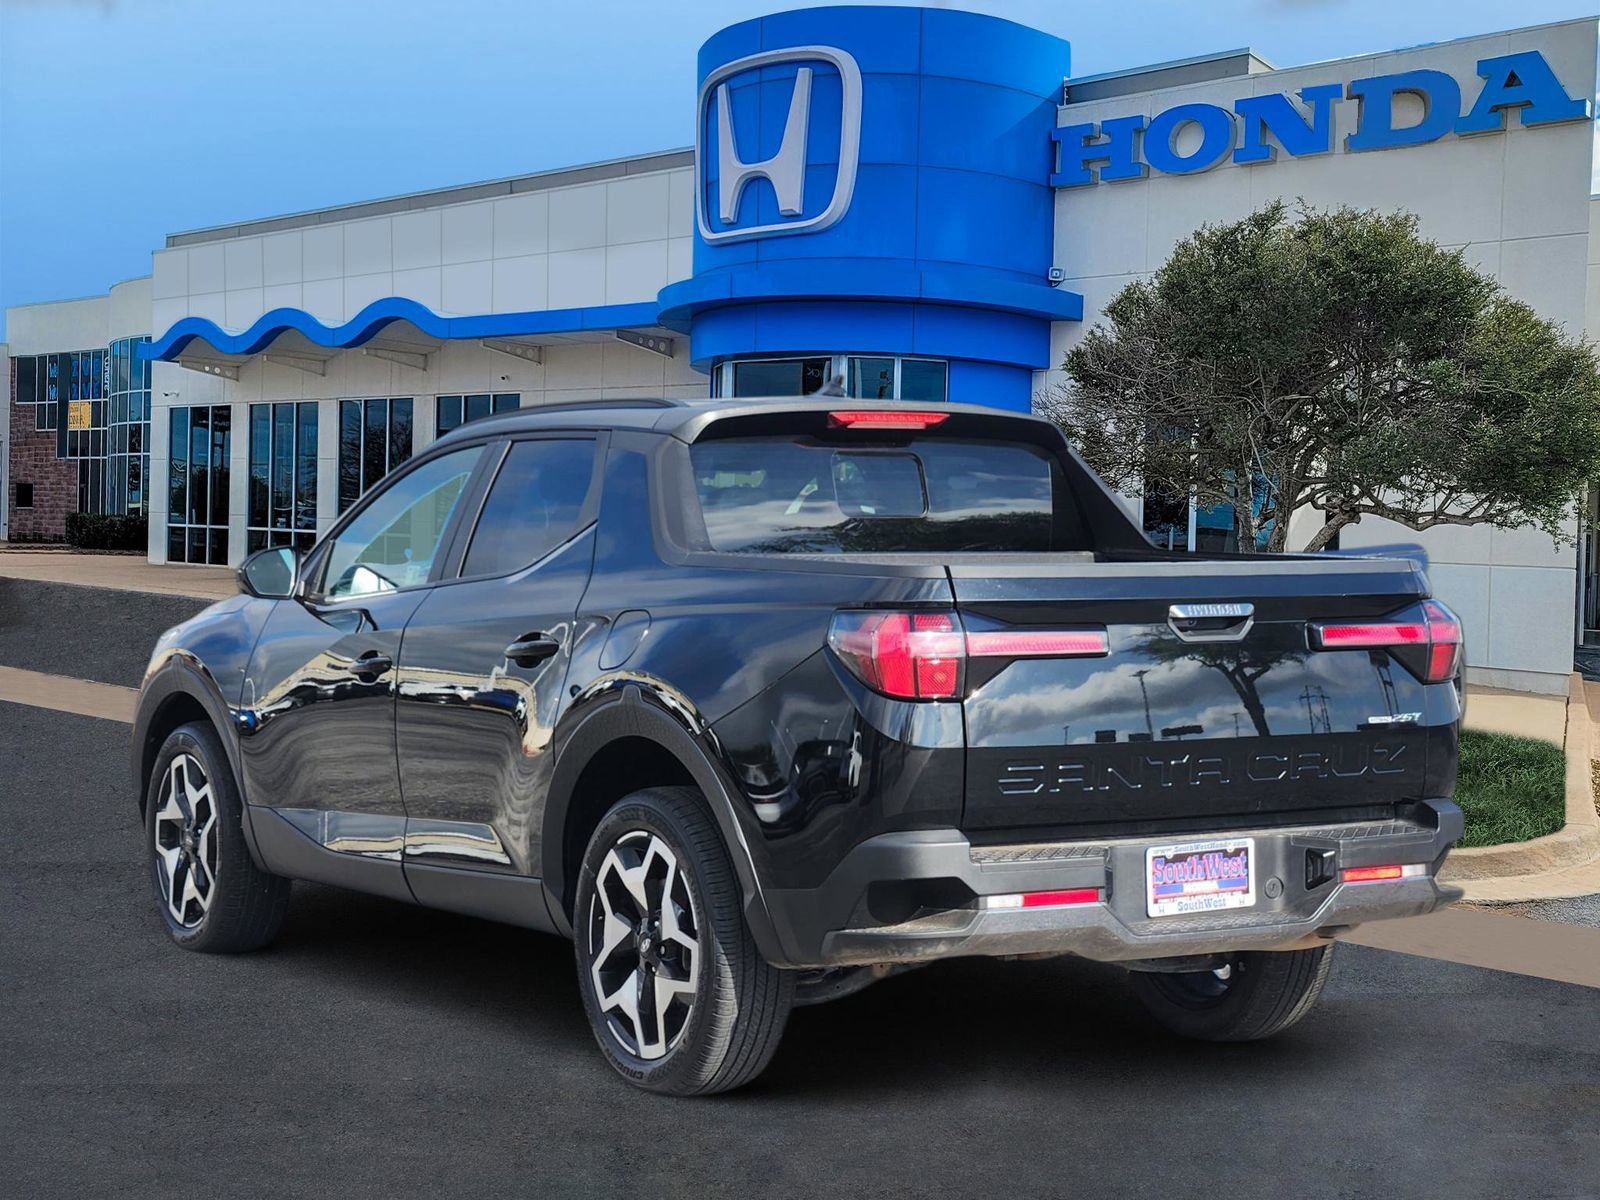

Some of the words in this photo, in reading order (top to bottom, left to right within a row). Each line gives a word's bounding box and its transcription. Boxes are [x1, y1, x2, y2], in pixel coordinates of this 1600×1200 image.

[1050, 50, 1591, 188] HONDA
[998, 754, 1230, 795] SANTA
[1247, 744, 1407, 782] CRUZ
[1152, 851, 1248, 885] SouthWest
[1177, 898, 1227, 912] SouthWest
